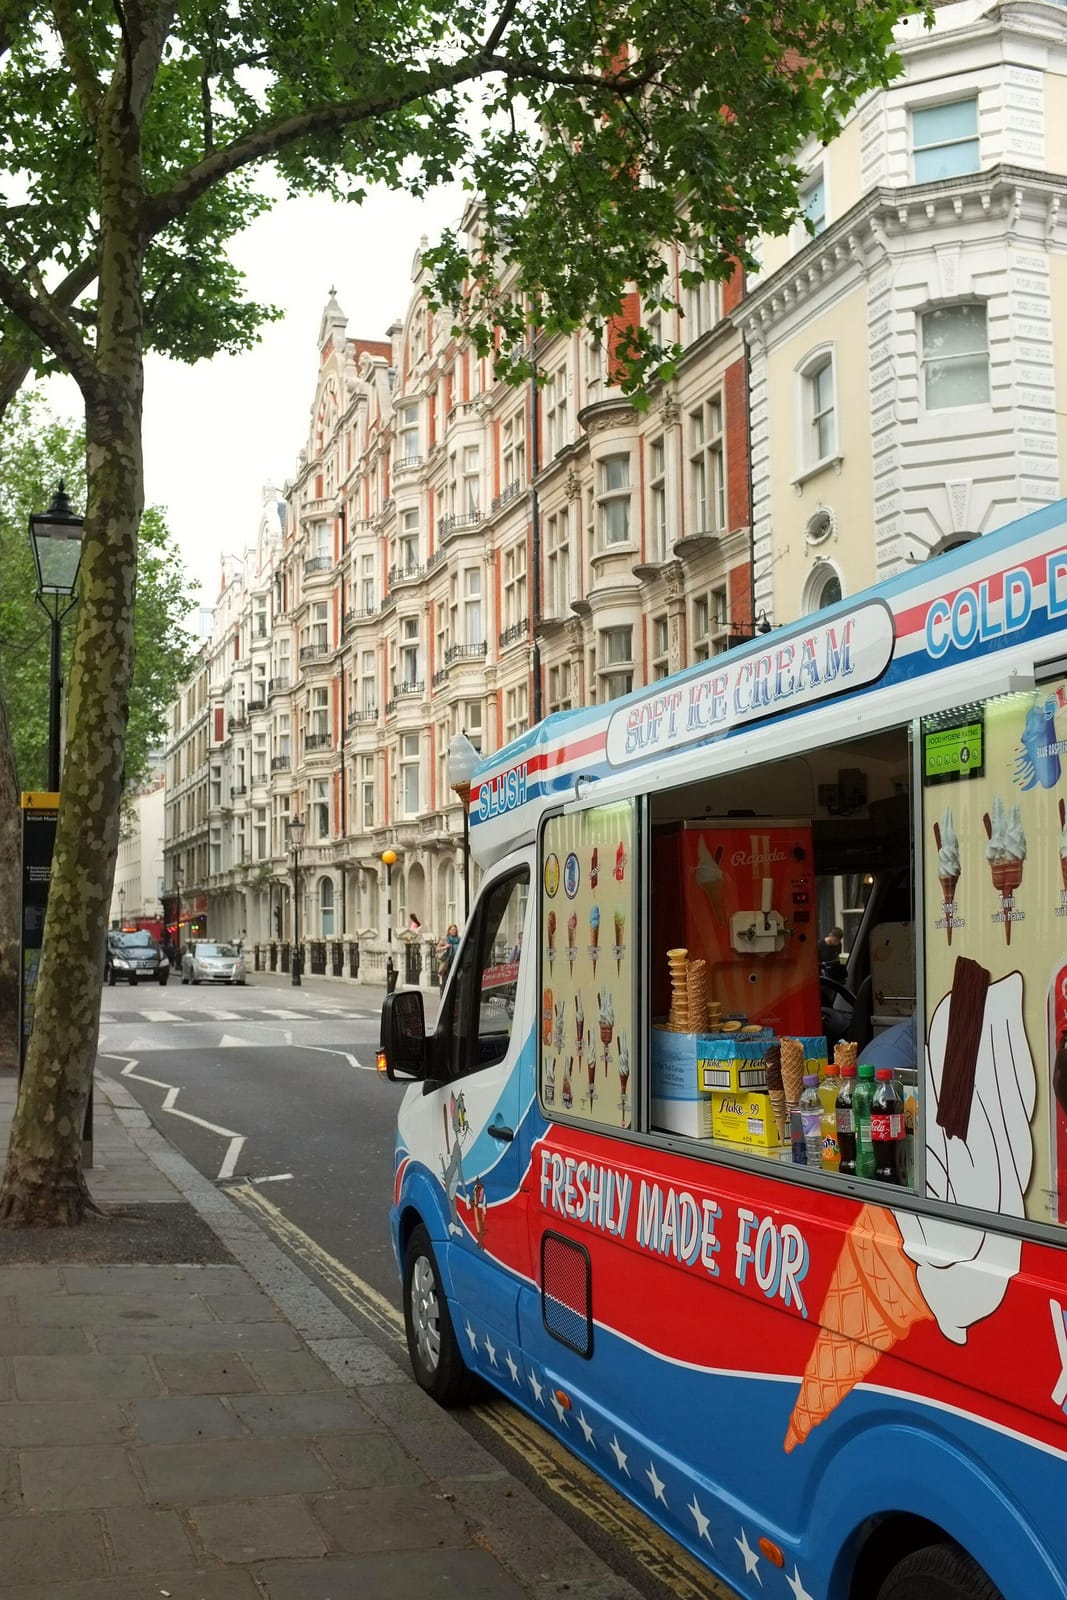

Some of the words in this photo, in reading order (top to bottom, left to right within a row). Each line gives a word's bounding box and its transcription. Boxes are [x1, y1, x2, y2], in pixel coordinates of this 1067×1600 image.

[925, 567, 1033, 658] COLD
[625, 690, 682, 755] SOFT
[686, 672, 728, 732] ICE
[733, 617, 856, 714] CREAM
[928, 736, 942, 745] FOOD
[961, 748, 968, 761] 4
[479, 762, 528, 820] SLUSH
[731, 848, 787, 867] Rapida
[718, 1098, 744, 1116] Flake
[750, 1103, 760, 1116] 99
[540, 1149, 632, 1239] FRESHLY
[636, 1179, 722, 1277] MADE
[735, 1207, 809, 1318] FOR
